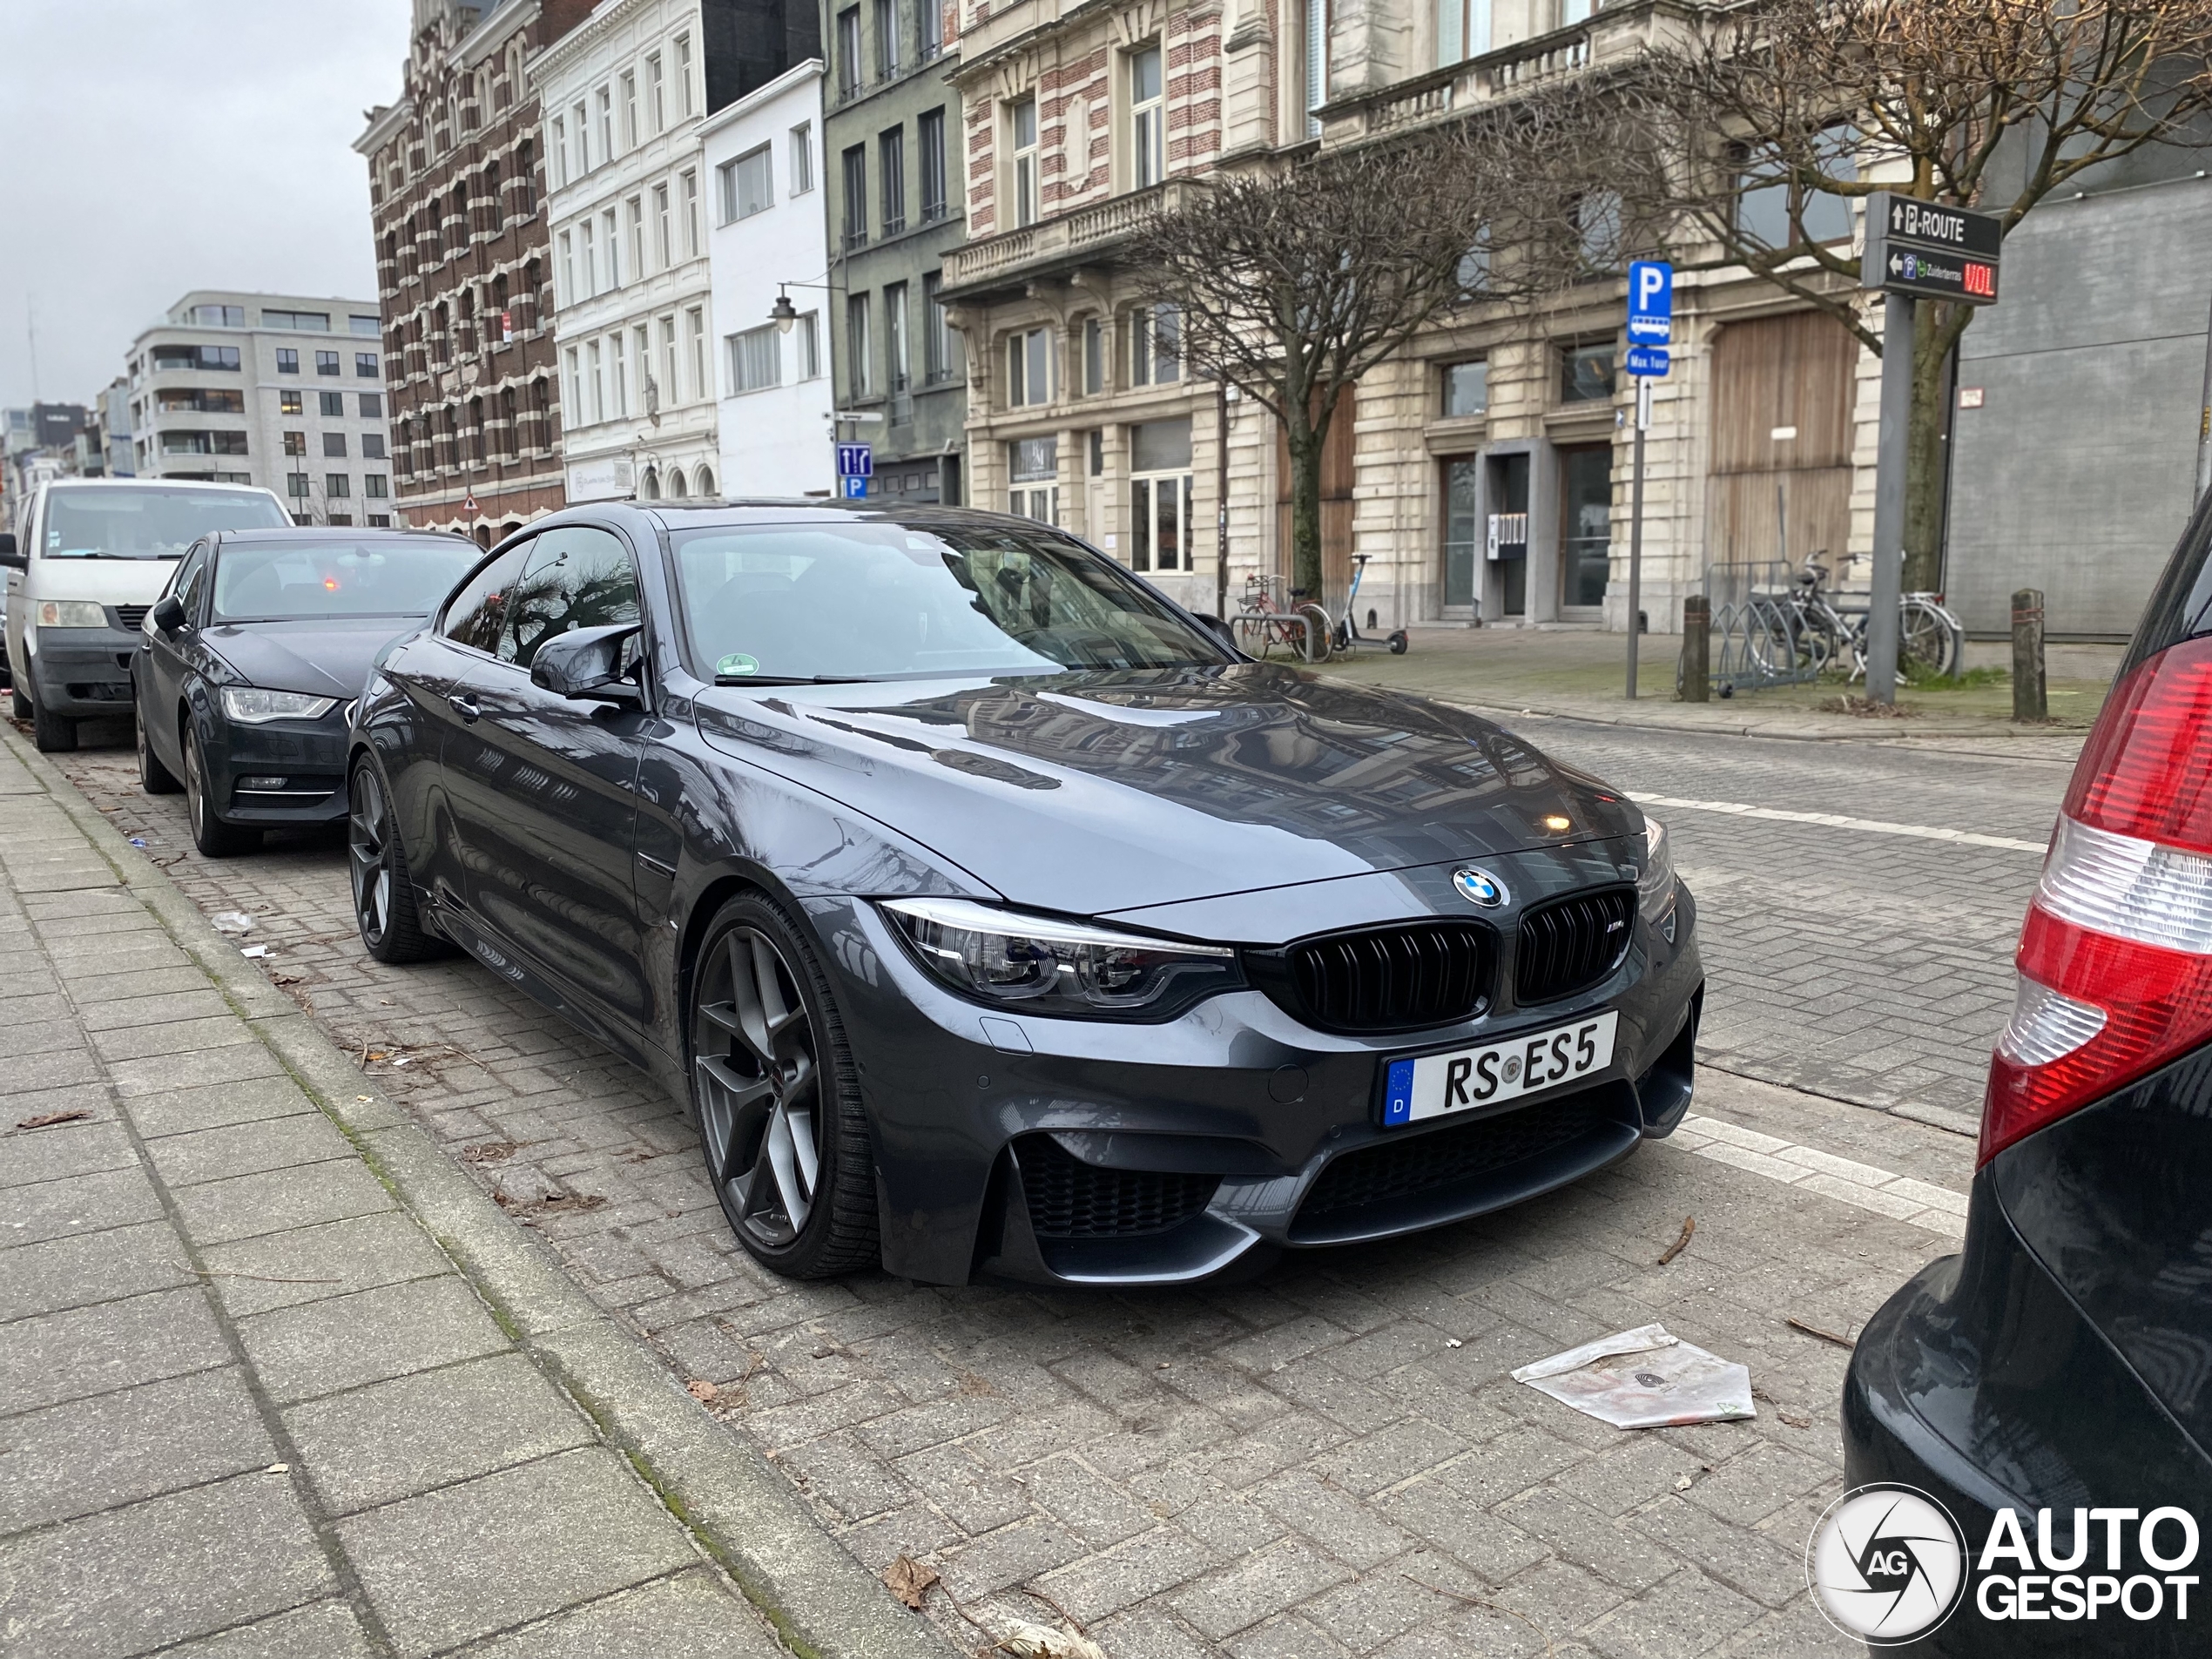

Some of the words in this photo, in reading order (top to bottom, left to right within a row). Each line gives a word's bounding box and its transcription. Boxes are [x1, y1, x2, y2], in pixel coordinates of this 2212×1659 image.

[1906, 206, 1964, 242] P-ROUTE
[1639, 266, 1663, 311] P
[1926, 263, 1962, 282] Zuiderterras
[1965, 263, 1994, 296] VOL
[850, 478, 861, 496] P
[1445, 1051, 1500, 1108] RS
[1393, 1099, 1403, 1113] D
